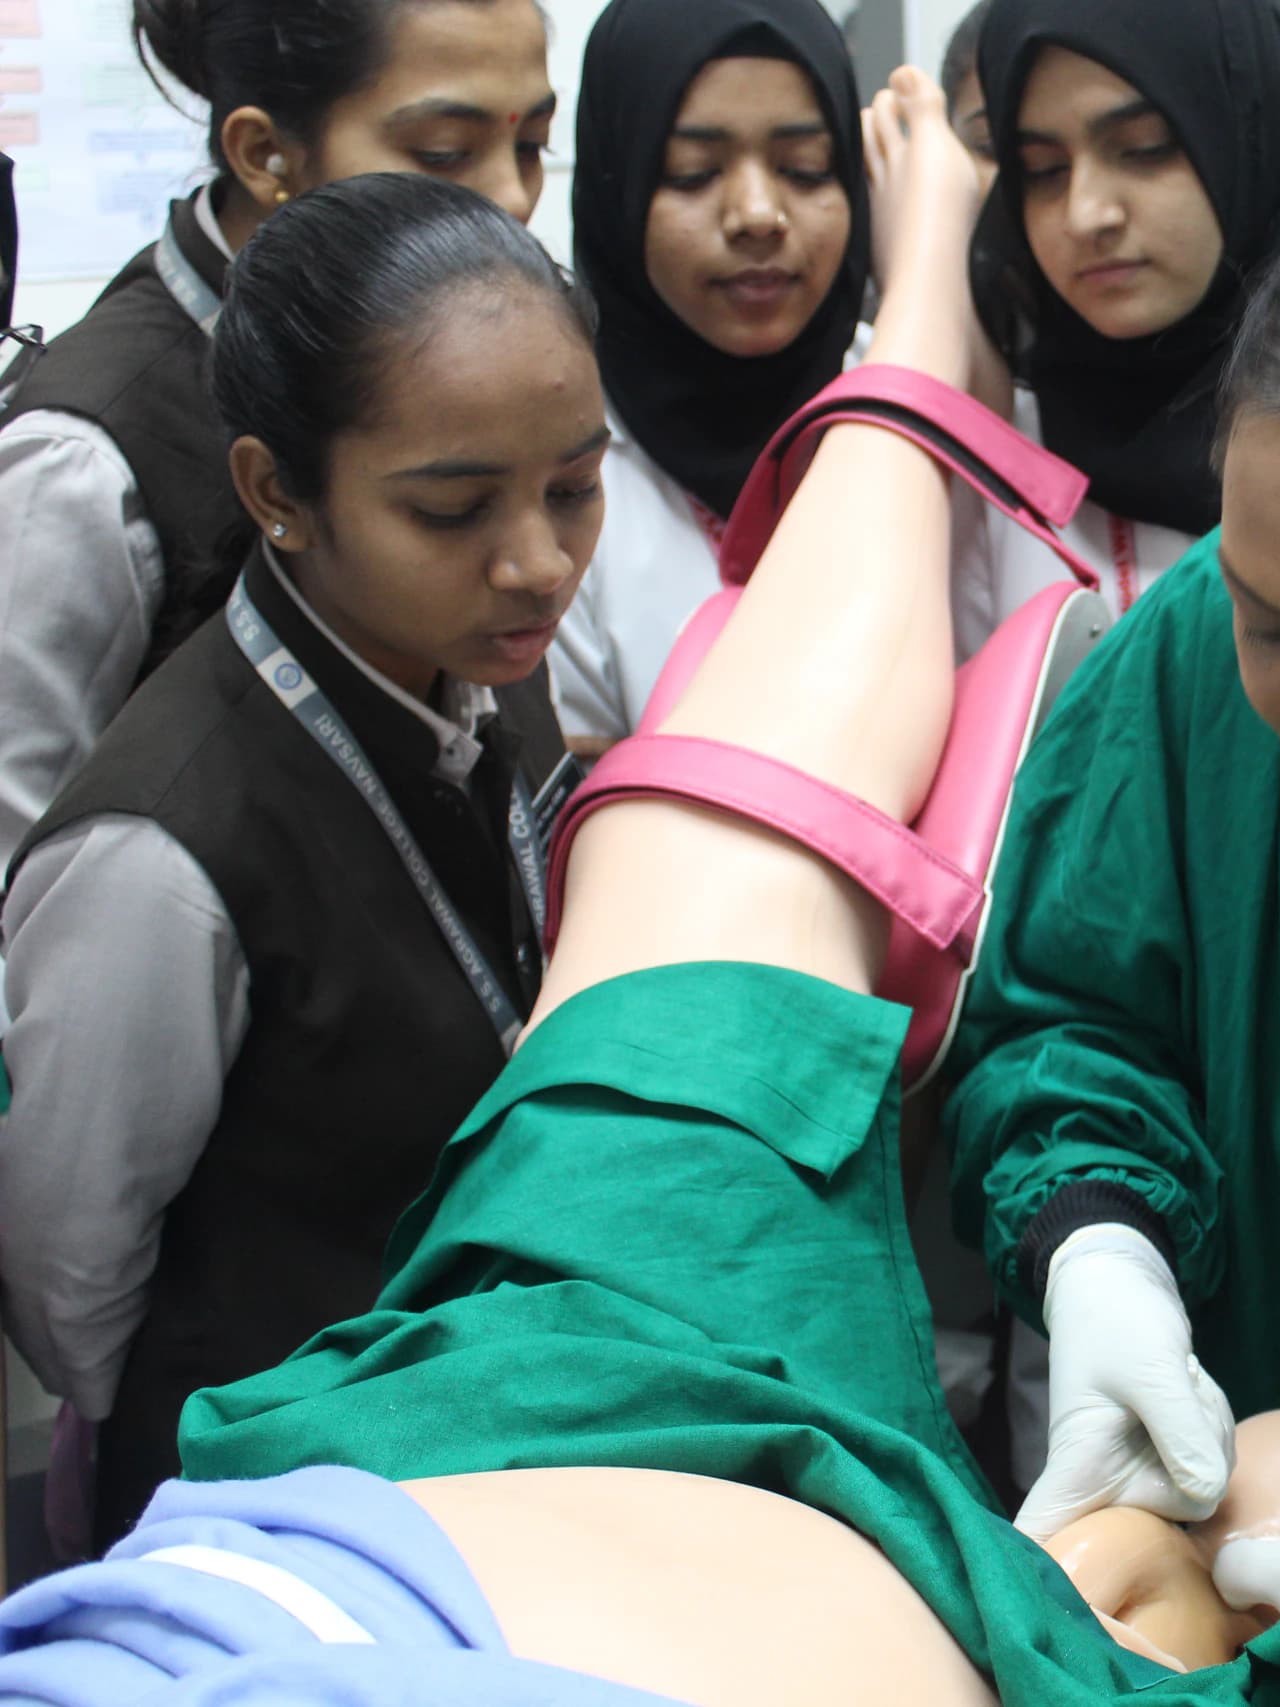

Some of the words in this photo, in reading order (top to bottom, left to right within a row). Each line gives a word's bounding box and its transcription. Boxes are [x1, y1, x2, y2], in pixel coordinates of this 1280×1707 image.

[314, 712, 377, 795] NAVSARI
[519, 841, 546, 926] GRAWAL
[430, 887, 482, 975] AGRAWAL
